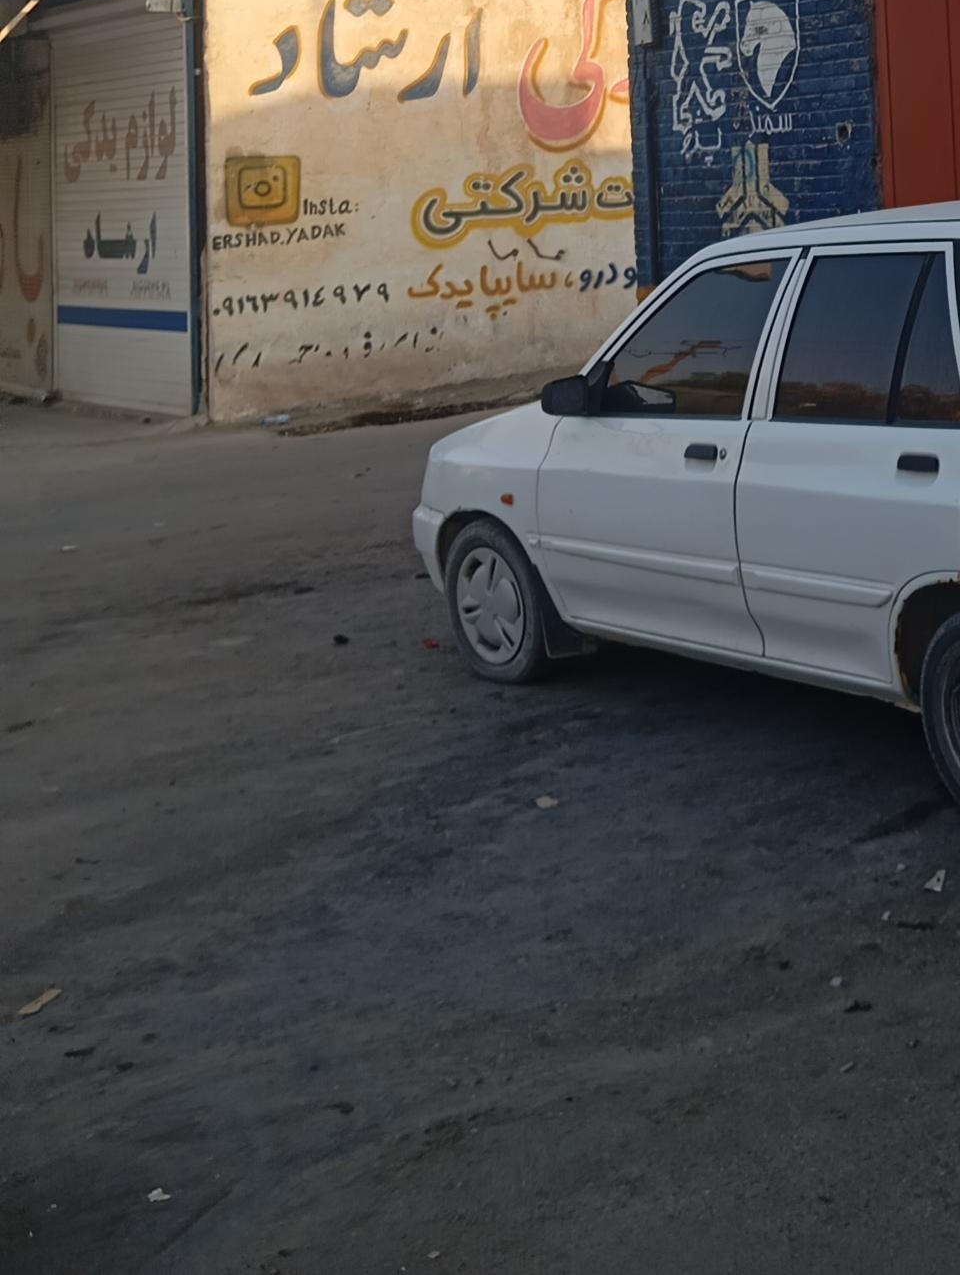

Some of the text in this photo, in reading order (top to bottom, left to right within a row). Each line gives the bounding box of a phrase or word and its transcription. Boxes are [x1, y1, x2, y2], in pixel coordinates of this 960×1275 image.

[64, 85, 176, 183] لوازم یدکی
[748, 104, 792, 138] سمند
[303, 198, 360, 216] Insta:
[419, 163, 591, 241] شرکتی
[212, 223, 347, 251] ERSHAD.YADAK
